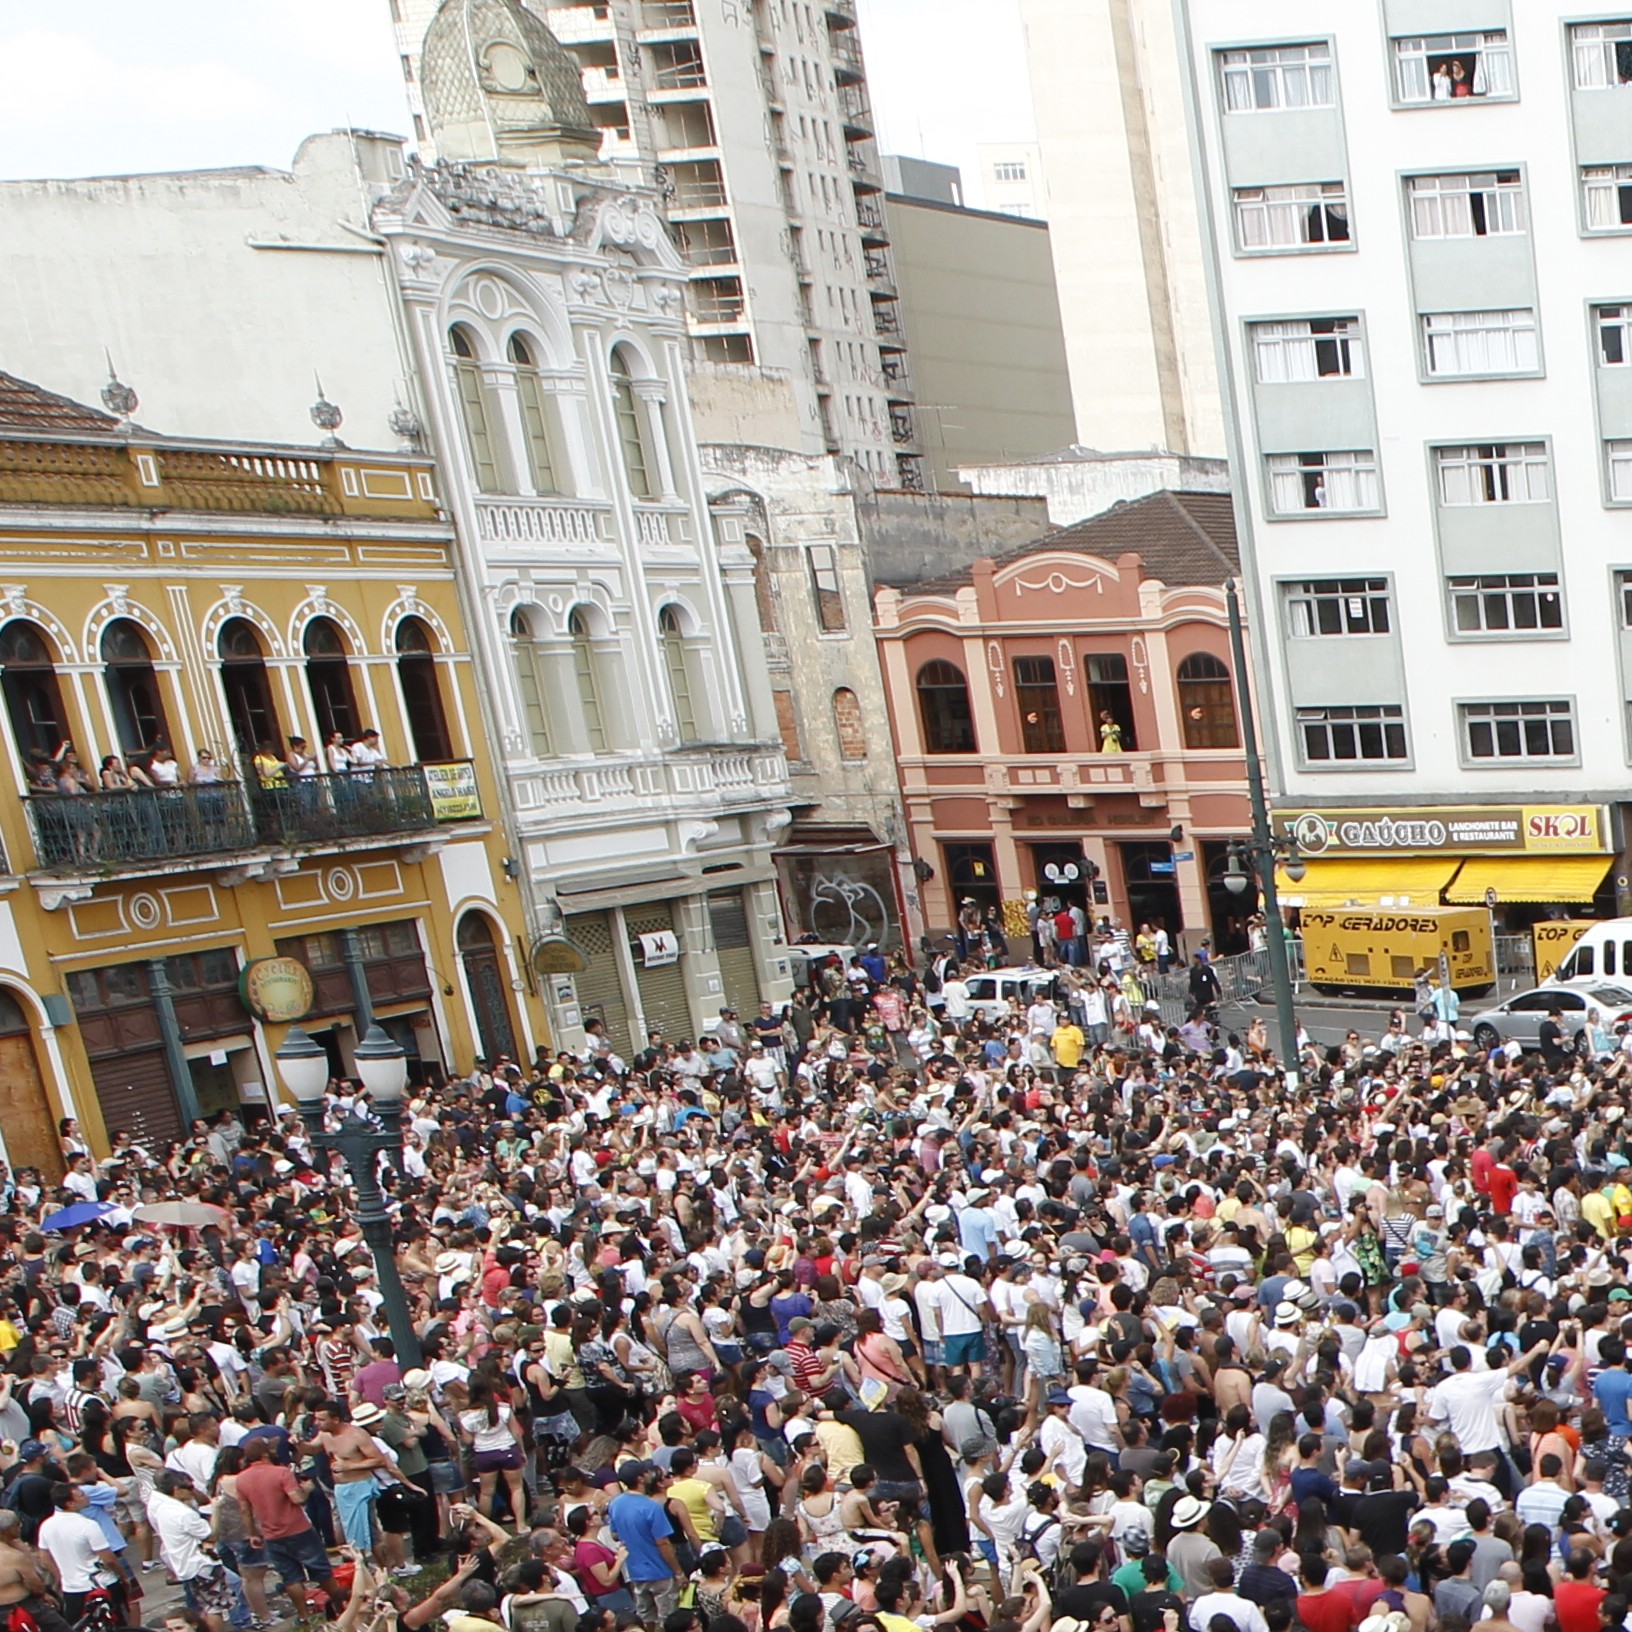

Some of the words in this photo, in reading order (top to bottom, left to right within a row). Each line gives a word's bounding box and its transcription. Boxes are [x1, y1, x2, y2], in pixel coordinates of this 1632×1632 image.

[1341, 816, 1447, 846] GAÚCHO
[1448, 822, 1500, 832] LANCHONETE
[1502, 821, 1518, 830] BAR
[1528, 813, 1592, 839] SKOL
[1460, 831, 1516, 841] RESTAURANTE
[1341, 916, 1439, 933] GERADORES
[1537, 928, 1568, 941] TOP
